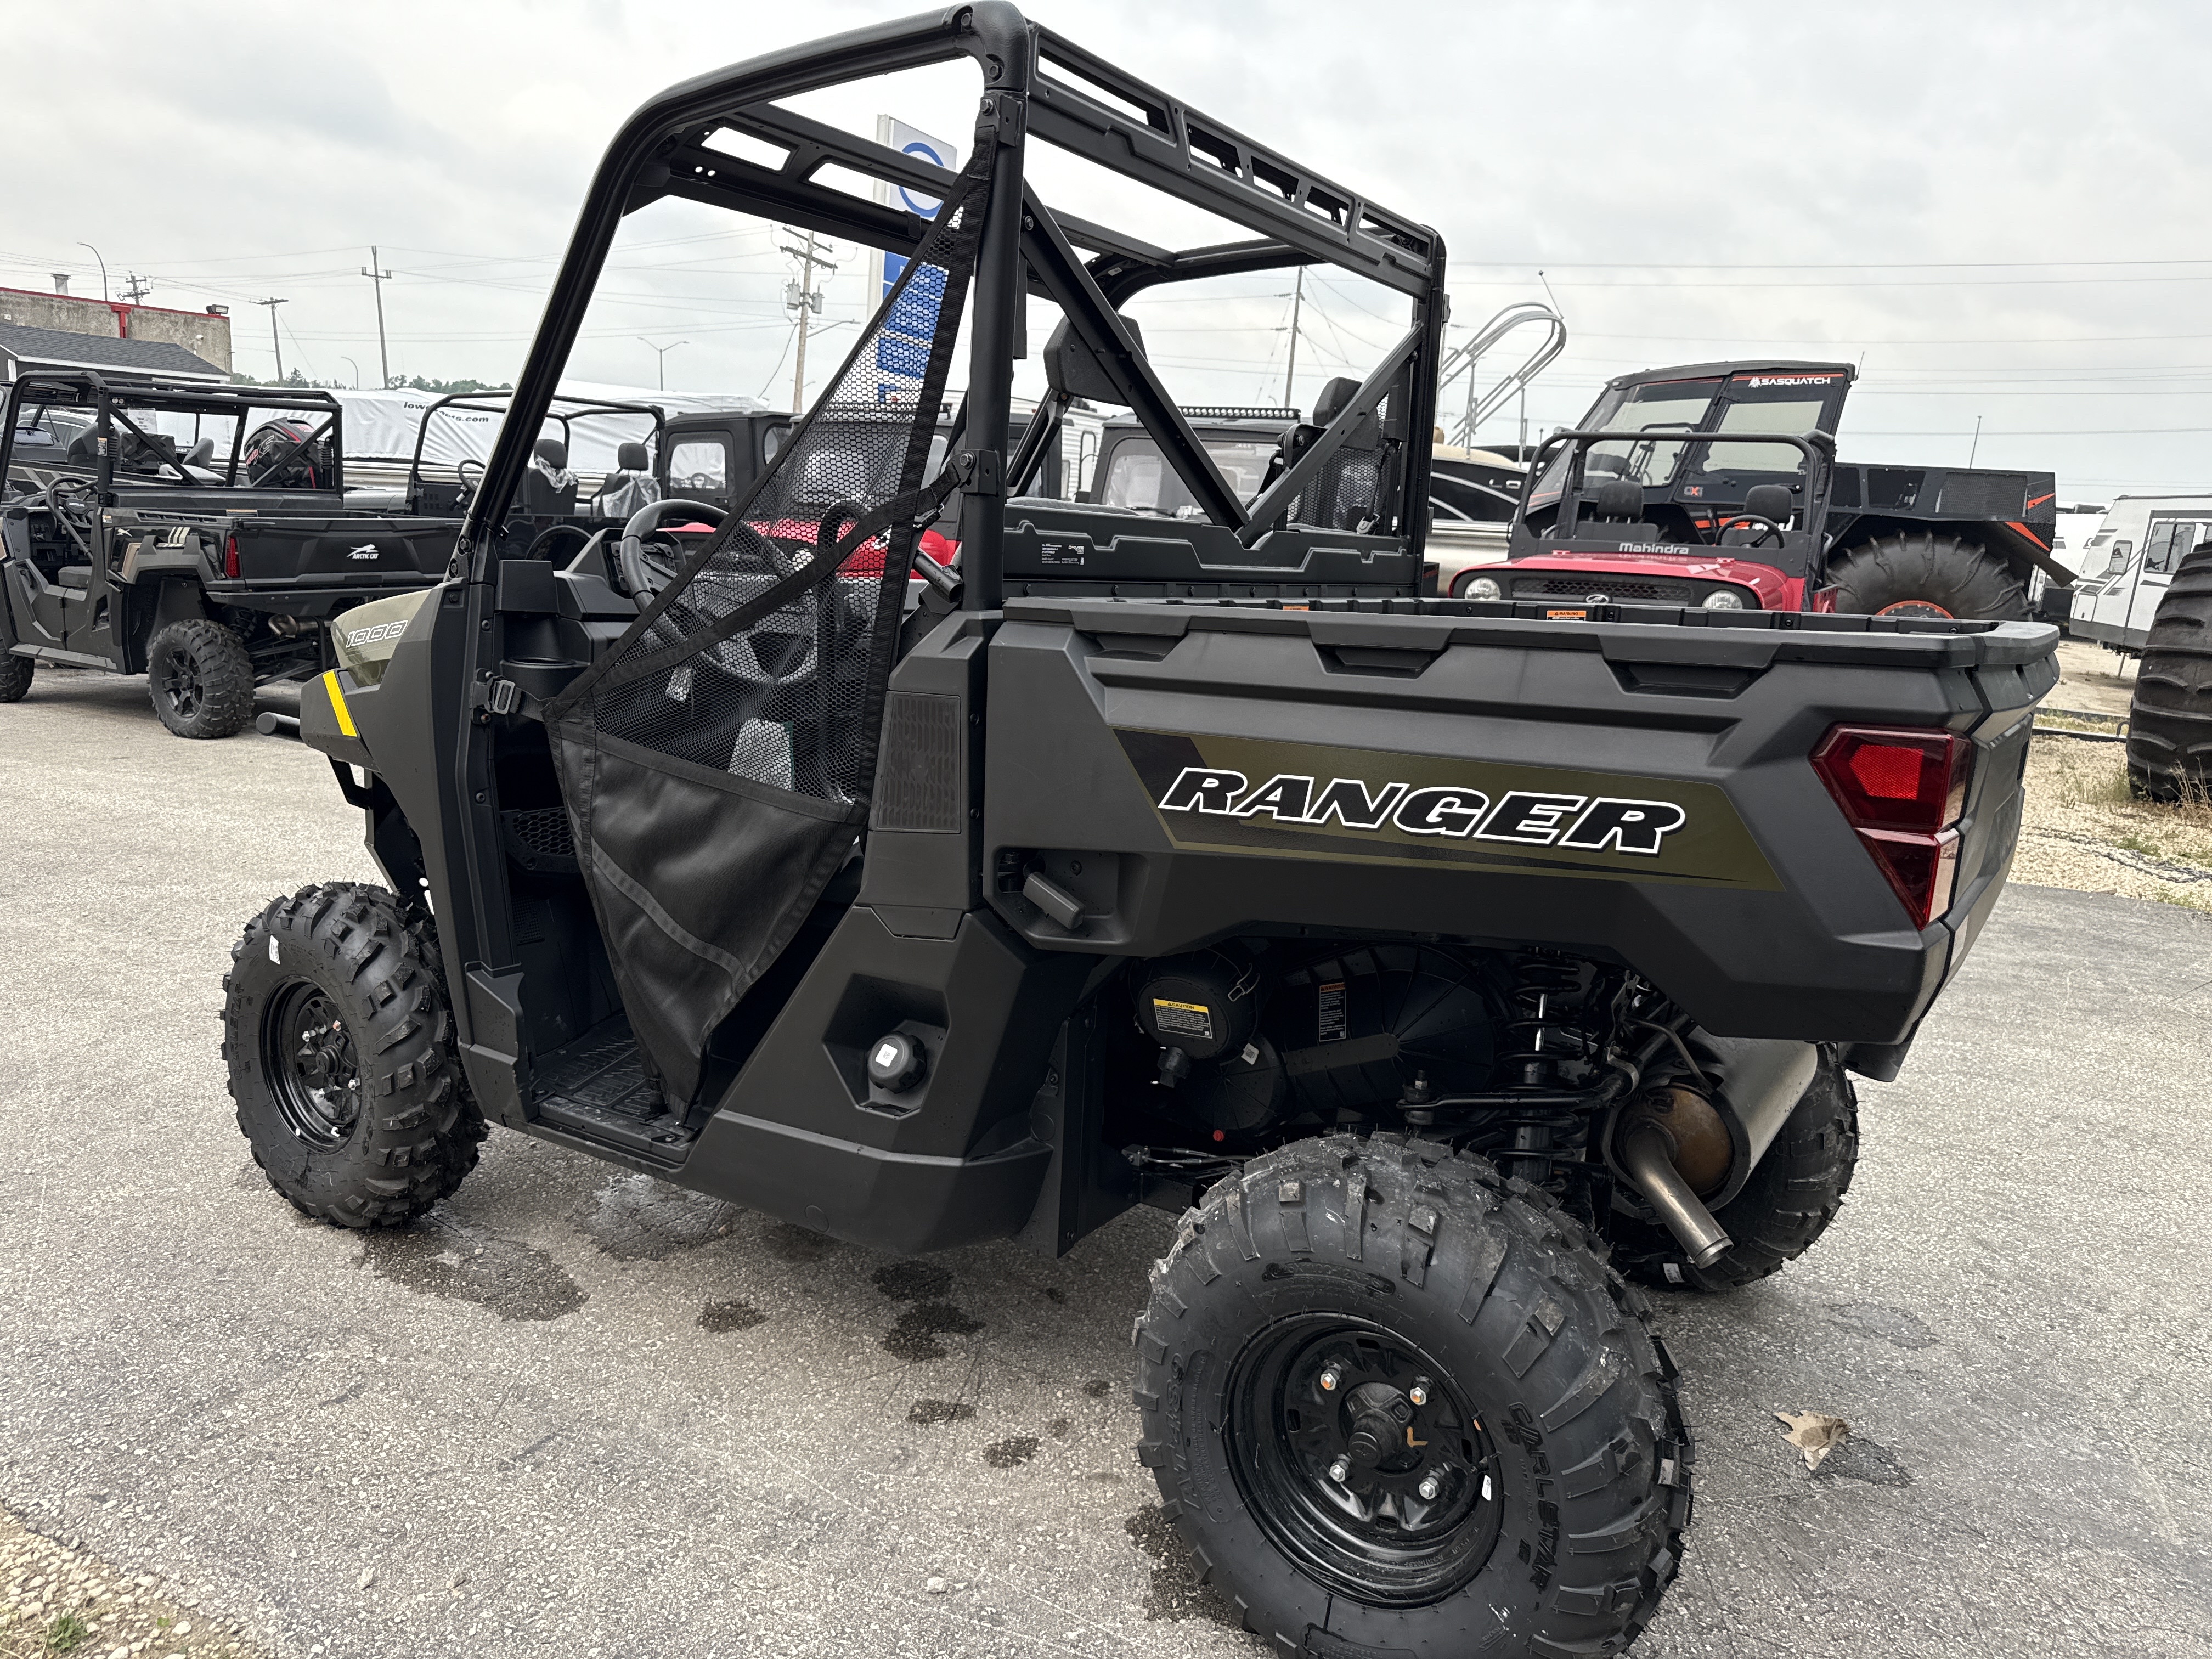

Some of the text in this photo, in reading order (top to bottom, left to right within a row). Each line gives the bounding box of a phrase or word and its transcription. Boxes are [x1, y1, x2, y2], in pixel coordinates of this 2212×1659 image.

[1761, 377, 1830, 386] SASQUATCH
[1619, 543, 1689, 555] Mahindra
[346, 619, 408, 648] 1000
[1157, 766, 1688, 855] RANGER
